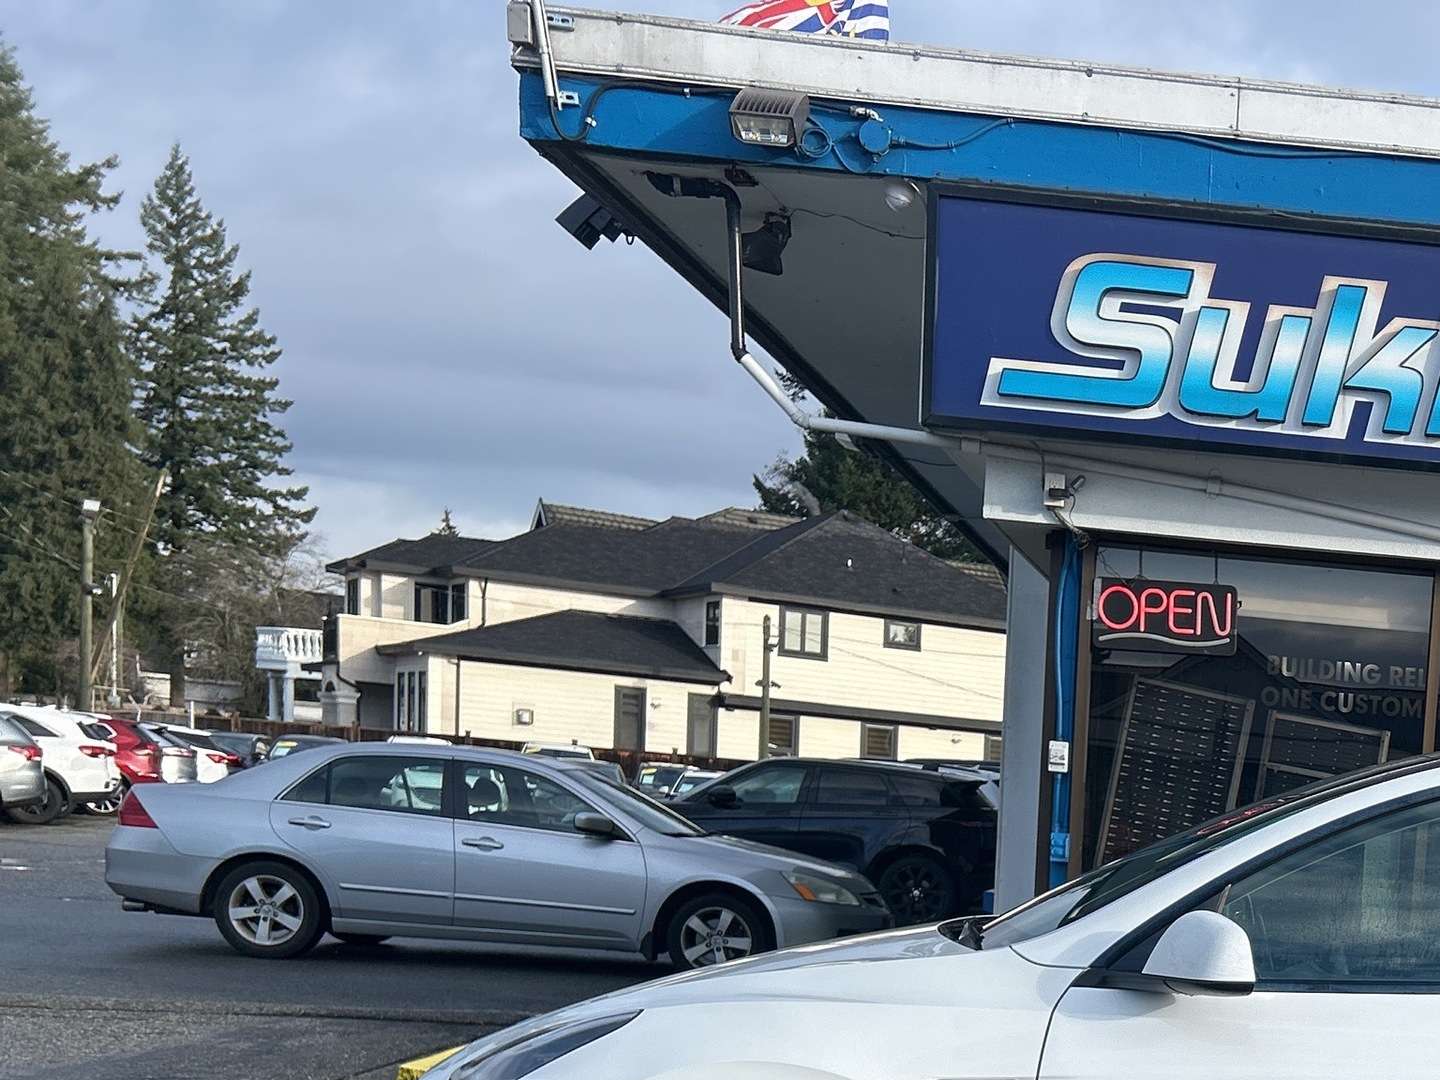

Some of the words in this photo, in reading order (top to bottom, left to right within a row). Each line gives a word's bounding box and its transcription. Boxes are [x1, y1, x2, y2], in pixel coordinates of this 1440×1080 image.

[1098, 585, 1232, 636] OPEN
[1267, 655, 1382, 684] BUILDING
[1261, 686, 1313, 709] ONE
